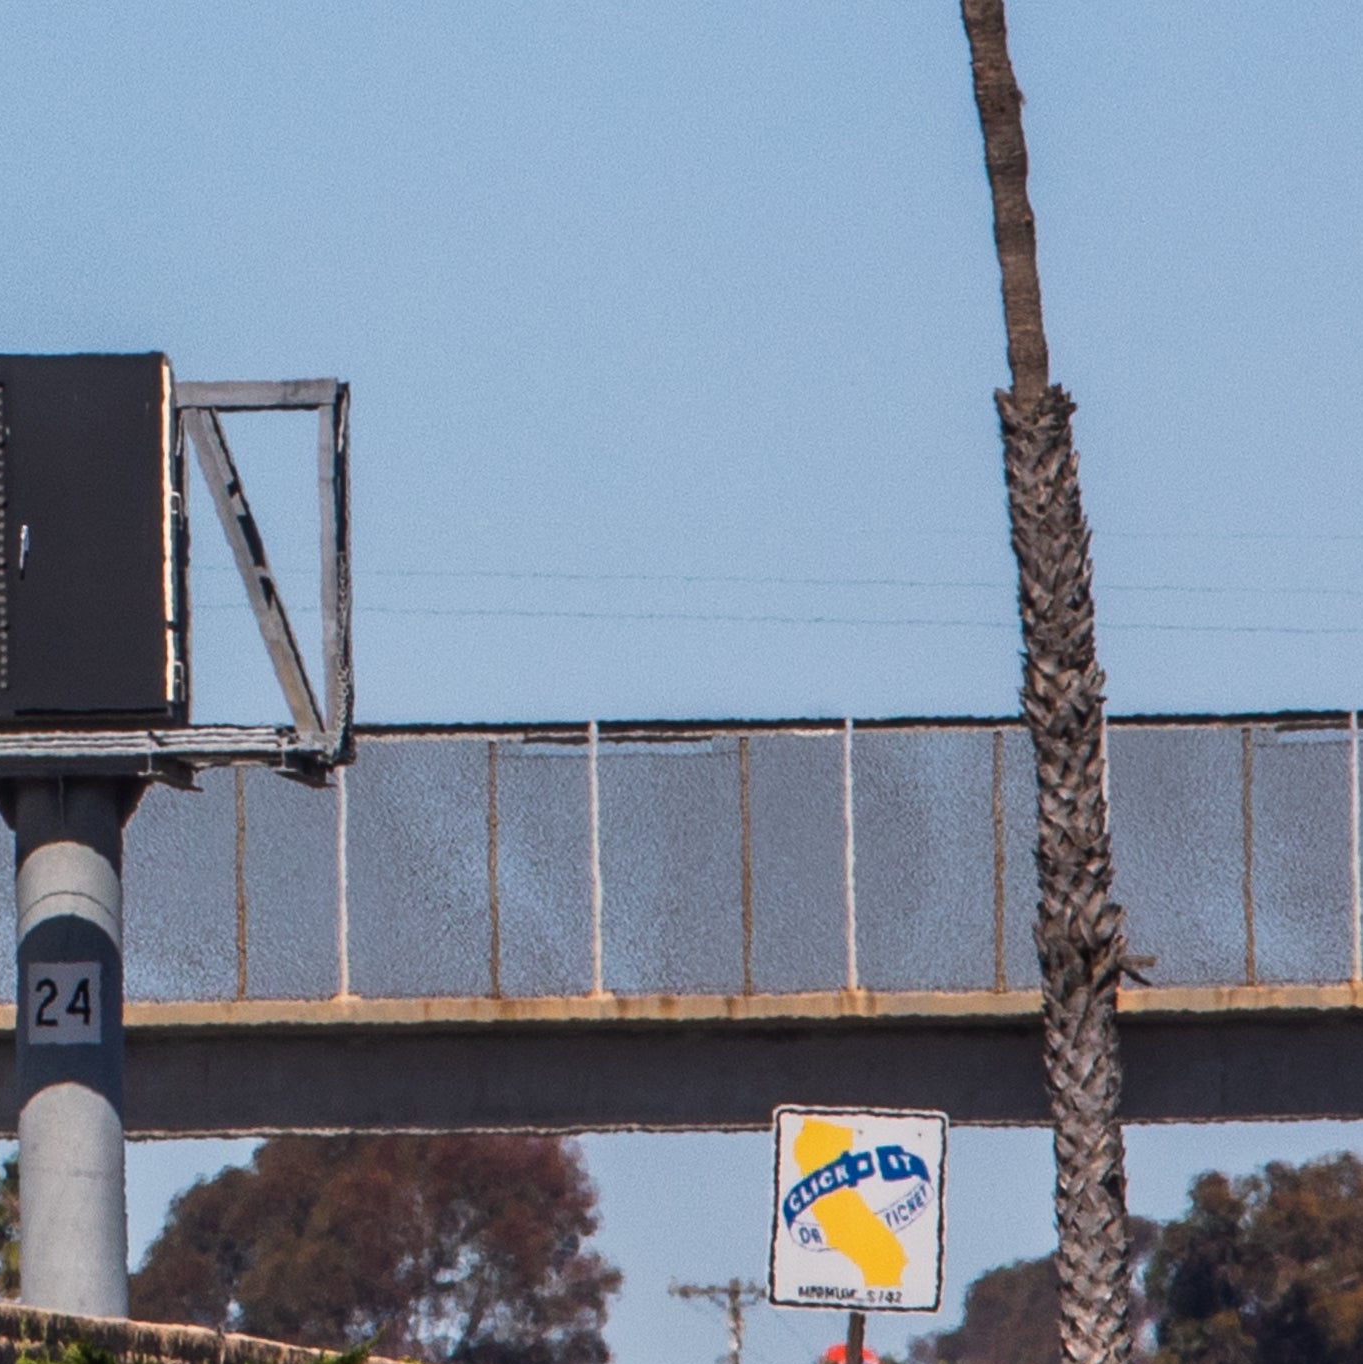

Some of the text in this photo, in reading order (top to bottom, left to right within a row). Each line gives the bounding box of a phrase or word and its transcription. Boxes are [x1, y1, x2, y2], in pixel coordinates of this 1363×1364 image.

[34, 977, 91, 1027] 24
[788, 1153, 913, 1213] CLICK IT
[799, 1185, 929, 1245] OR TICKET
